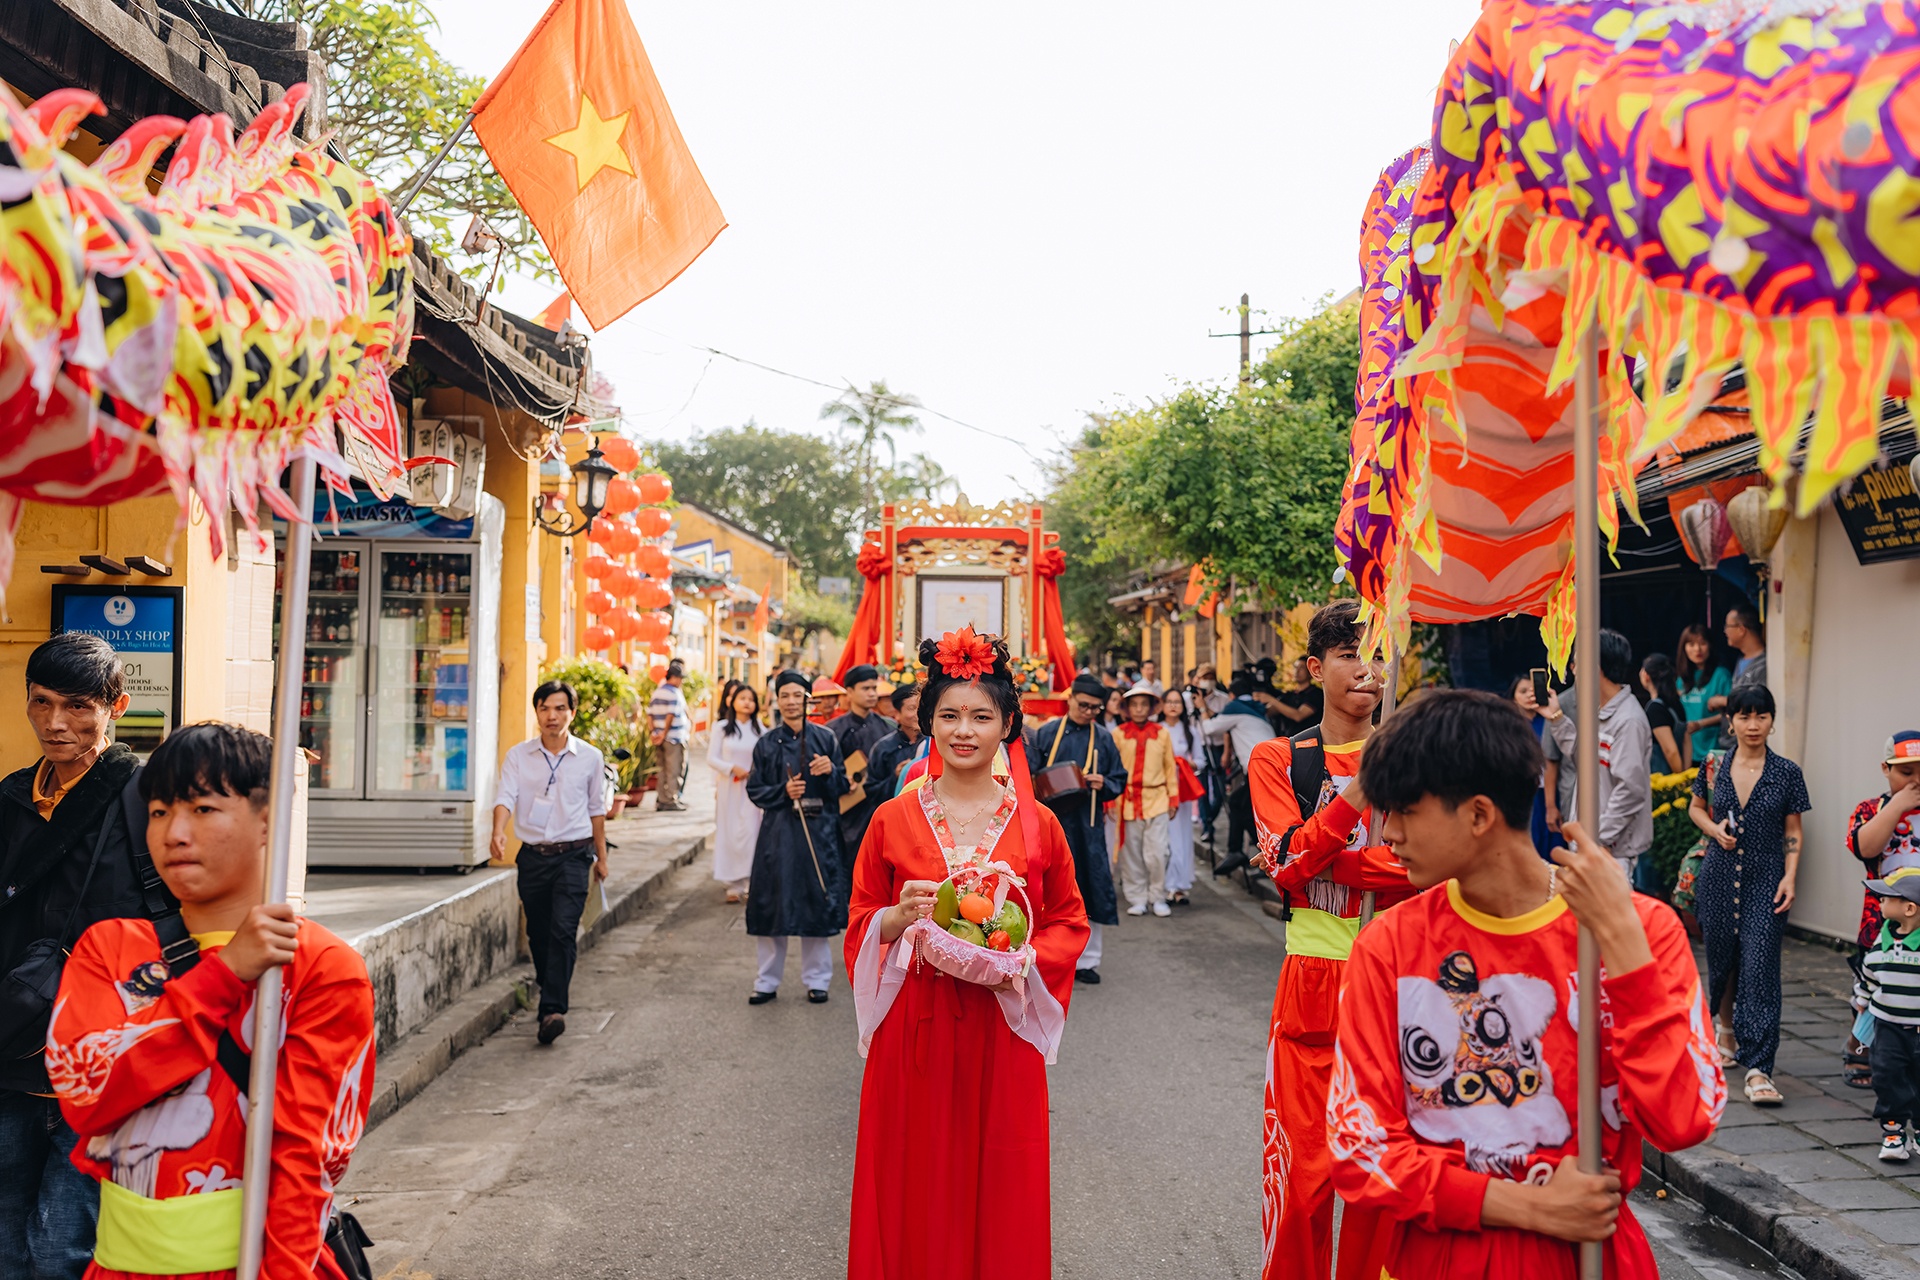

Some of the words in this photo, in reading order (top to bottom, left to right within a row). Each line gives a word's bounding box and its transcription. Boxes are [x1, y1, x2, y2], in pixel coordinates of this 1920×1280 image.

[343, 505, 416, 522] ALASKA
[67, 629, 133, 641] ENDLY
[135, 630, 171, 641] SHOP
[124, 663, 142, 677] 01
